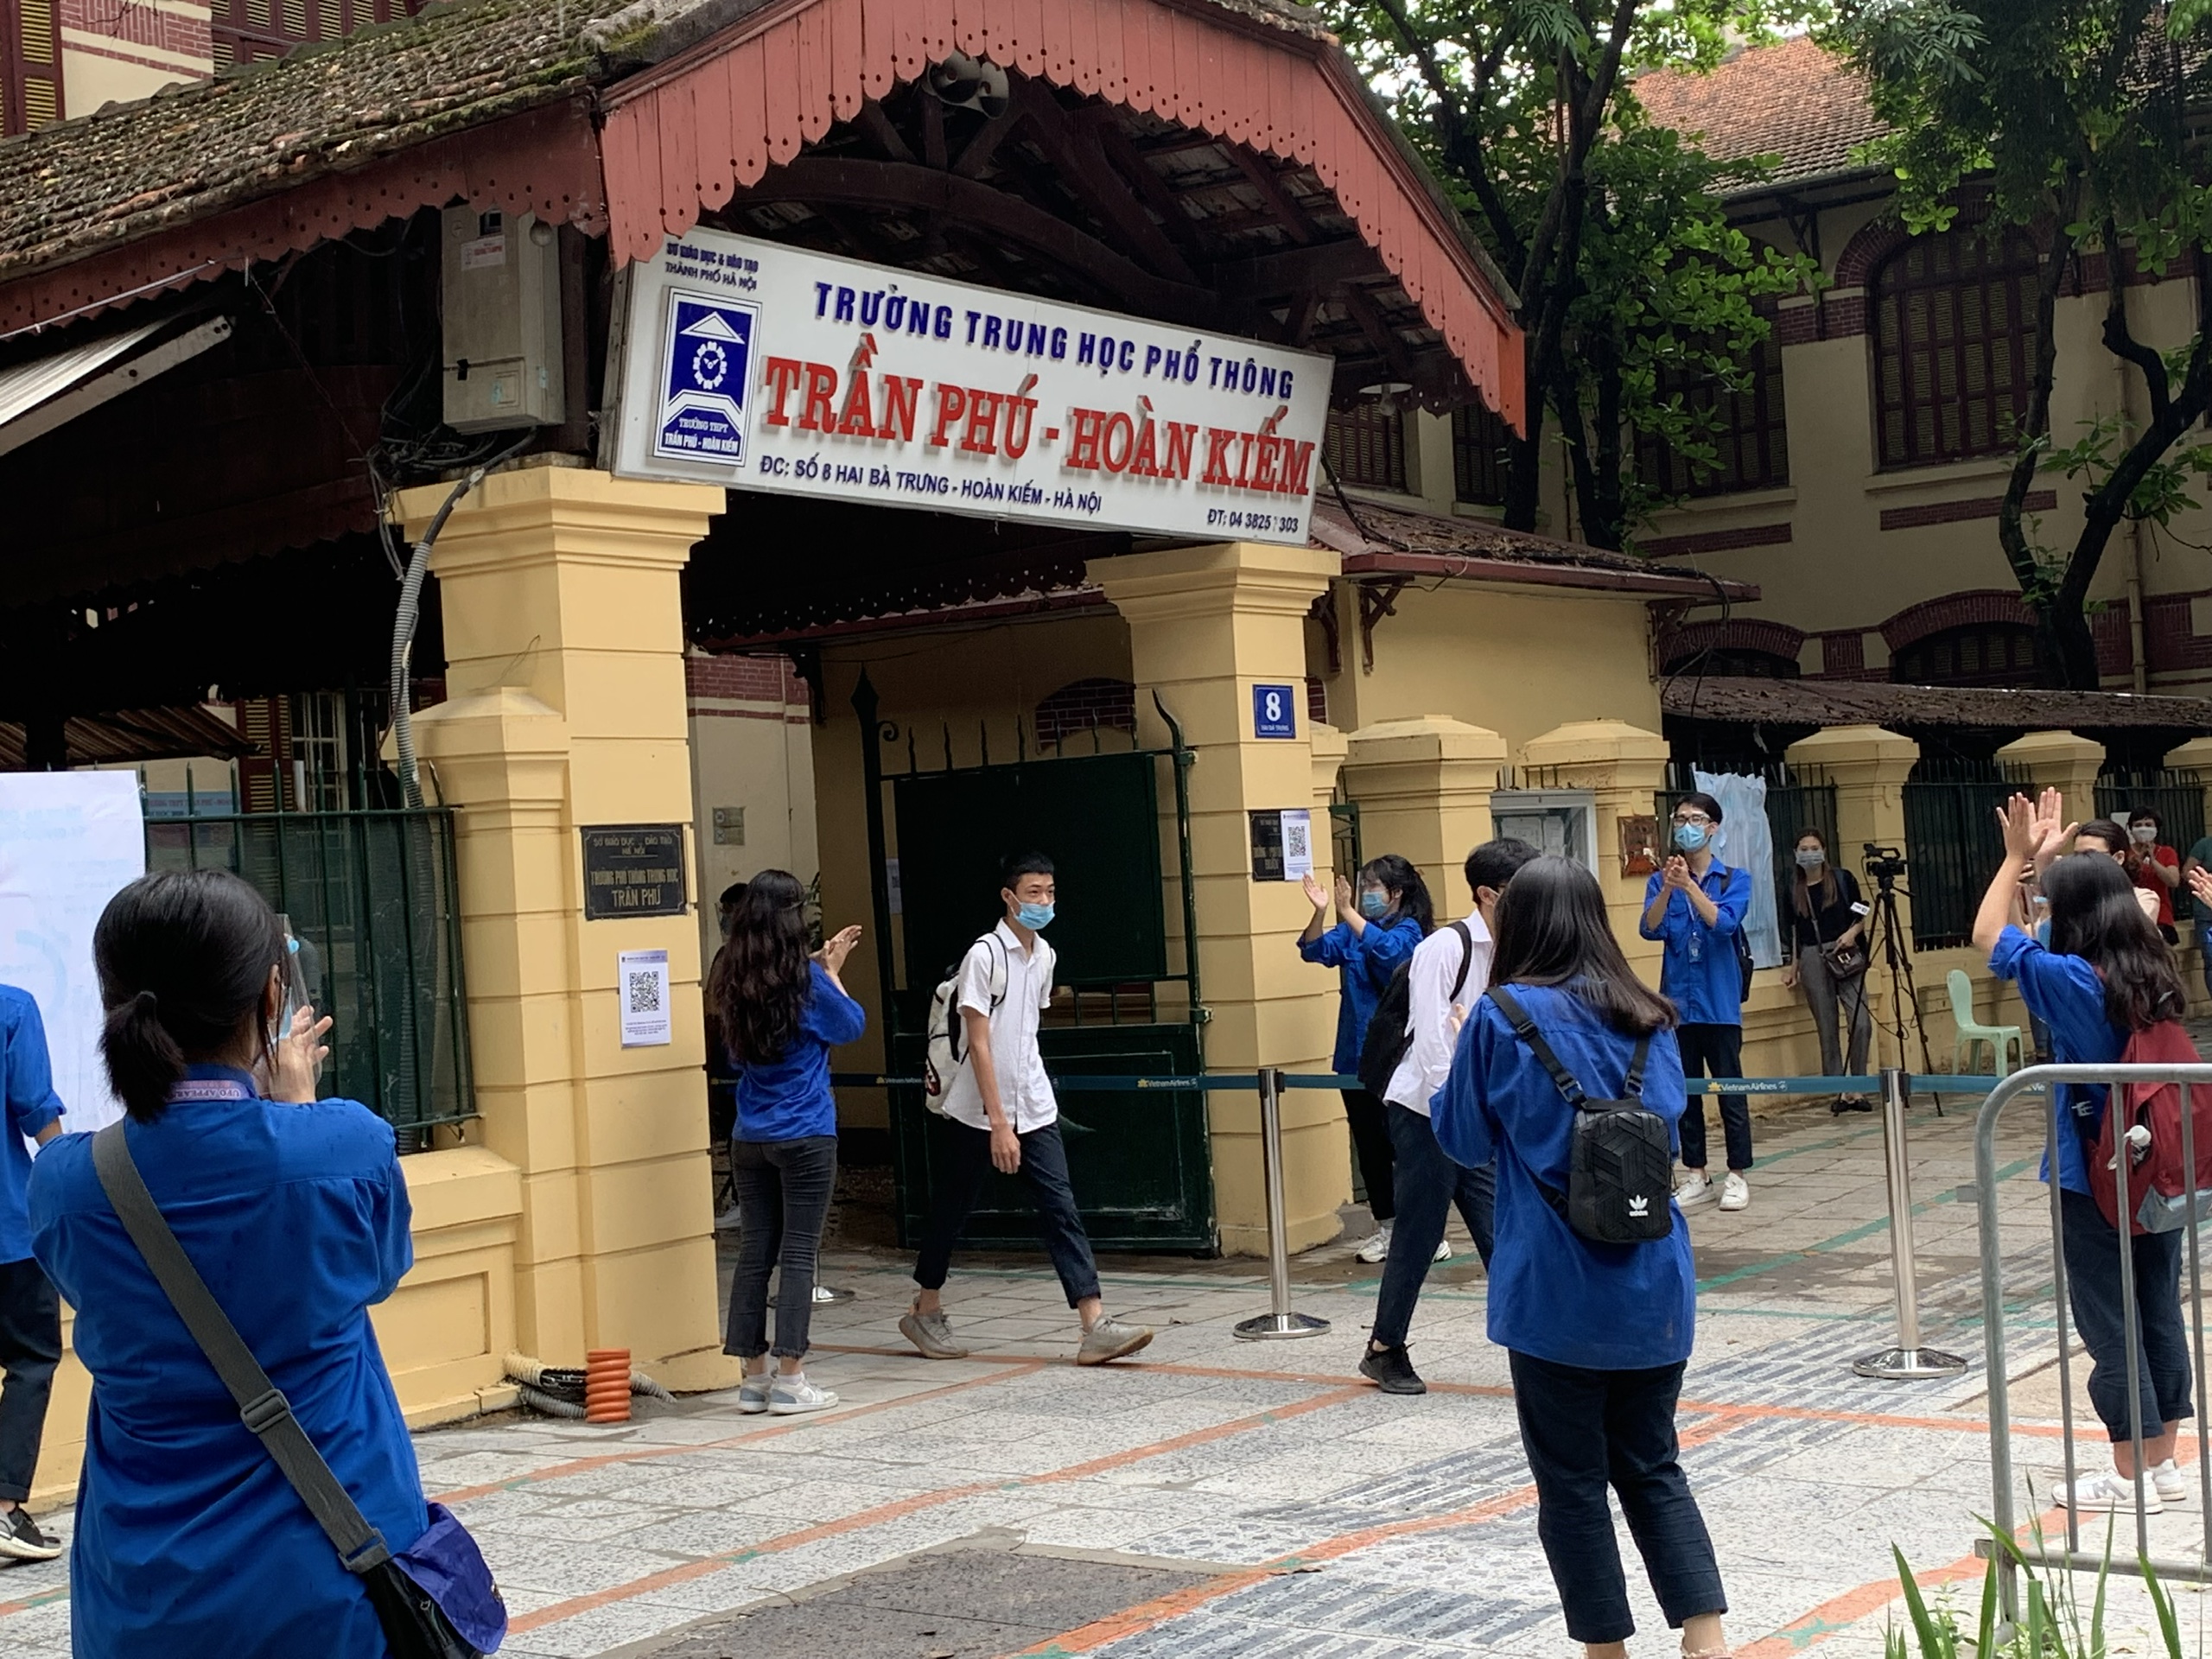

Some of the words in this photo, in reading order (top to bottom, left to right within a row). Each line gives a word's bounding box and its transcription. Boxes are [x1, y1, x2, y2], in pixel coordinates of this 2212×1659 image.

[718, 253, 724, 266] &
[665, 261, 698, 279] THÀNH
[700, 268, 721, 283] PHỐ
[722, 271, 737, 286] HÀ
[739, 276, 757, 292] NỘI
[815, 281, 953, 340] TRƯỜNG
[963, 309, 1068, 360] TRUNG
[1078, 332, 1135, 377] HỌC
[1144, 339, 1202, 384] PHỔ
[1209, 357, 1294, 400] THÔNG
[709, 421, 728, 434] THPT
[762, 332, 925, 443] TRẦN
[928, 373, 1039, 461] PHÚ
[1065, 395, 1199, 481] HOÀN
[1200, 405, 1316, 496] KIẾM
[760, 454, 790, 476] ĐC:
[795, 452, 820, 479] SỐ
[822, 463, 831, 481] 8
[836, 465, 864, 485] HAI
[868, 464, 891, 487] BÀ
[895, 471, 949, 495] TRƯNG
[961, 477, 1004, 501] HOÀN
[1007, 479, 1043, 505] KIẾM
[1052, 486, 1074, 509] HÀ
[1077, 491, 1103, 516] NỘI
[1207, 508, 1227, 526] ĐT:
[1229, 512, 1243, 528] 04
[1266, 691, 1281, 721] 8
[641, 884, 662, 906] PHÚ
